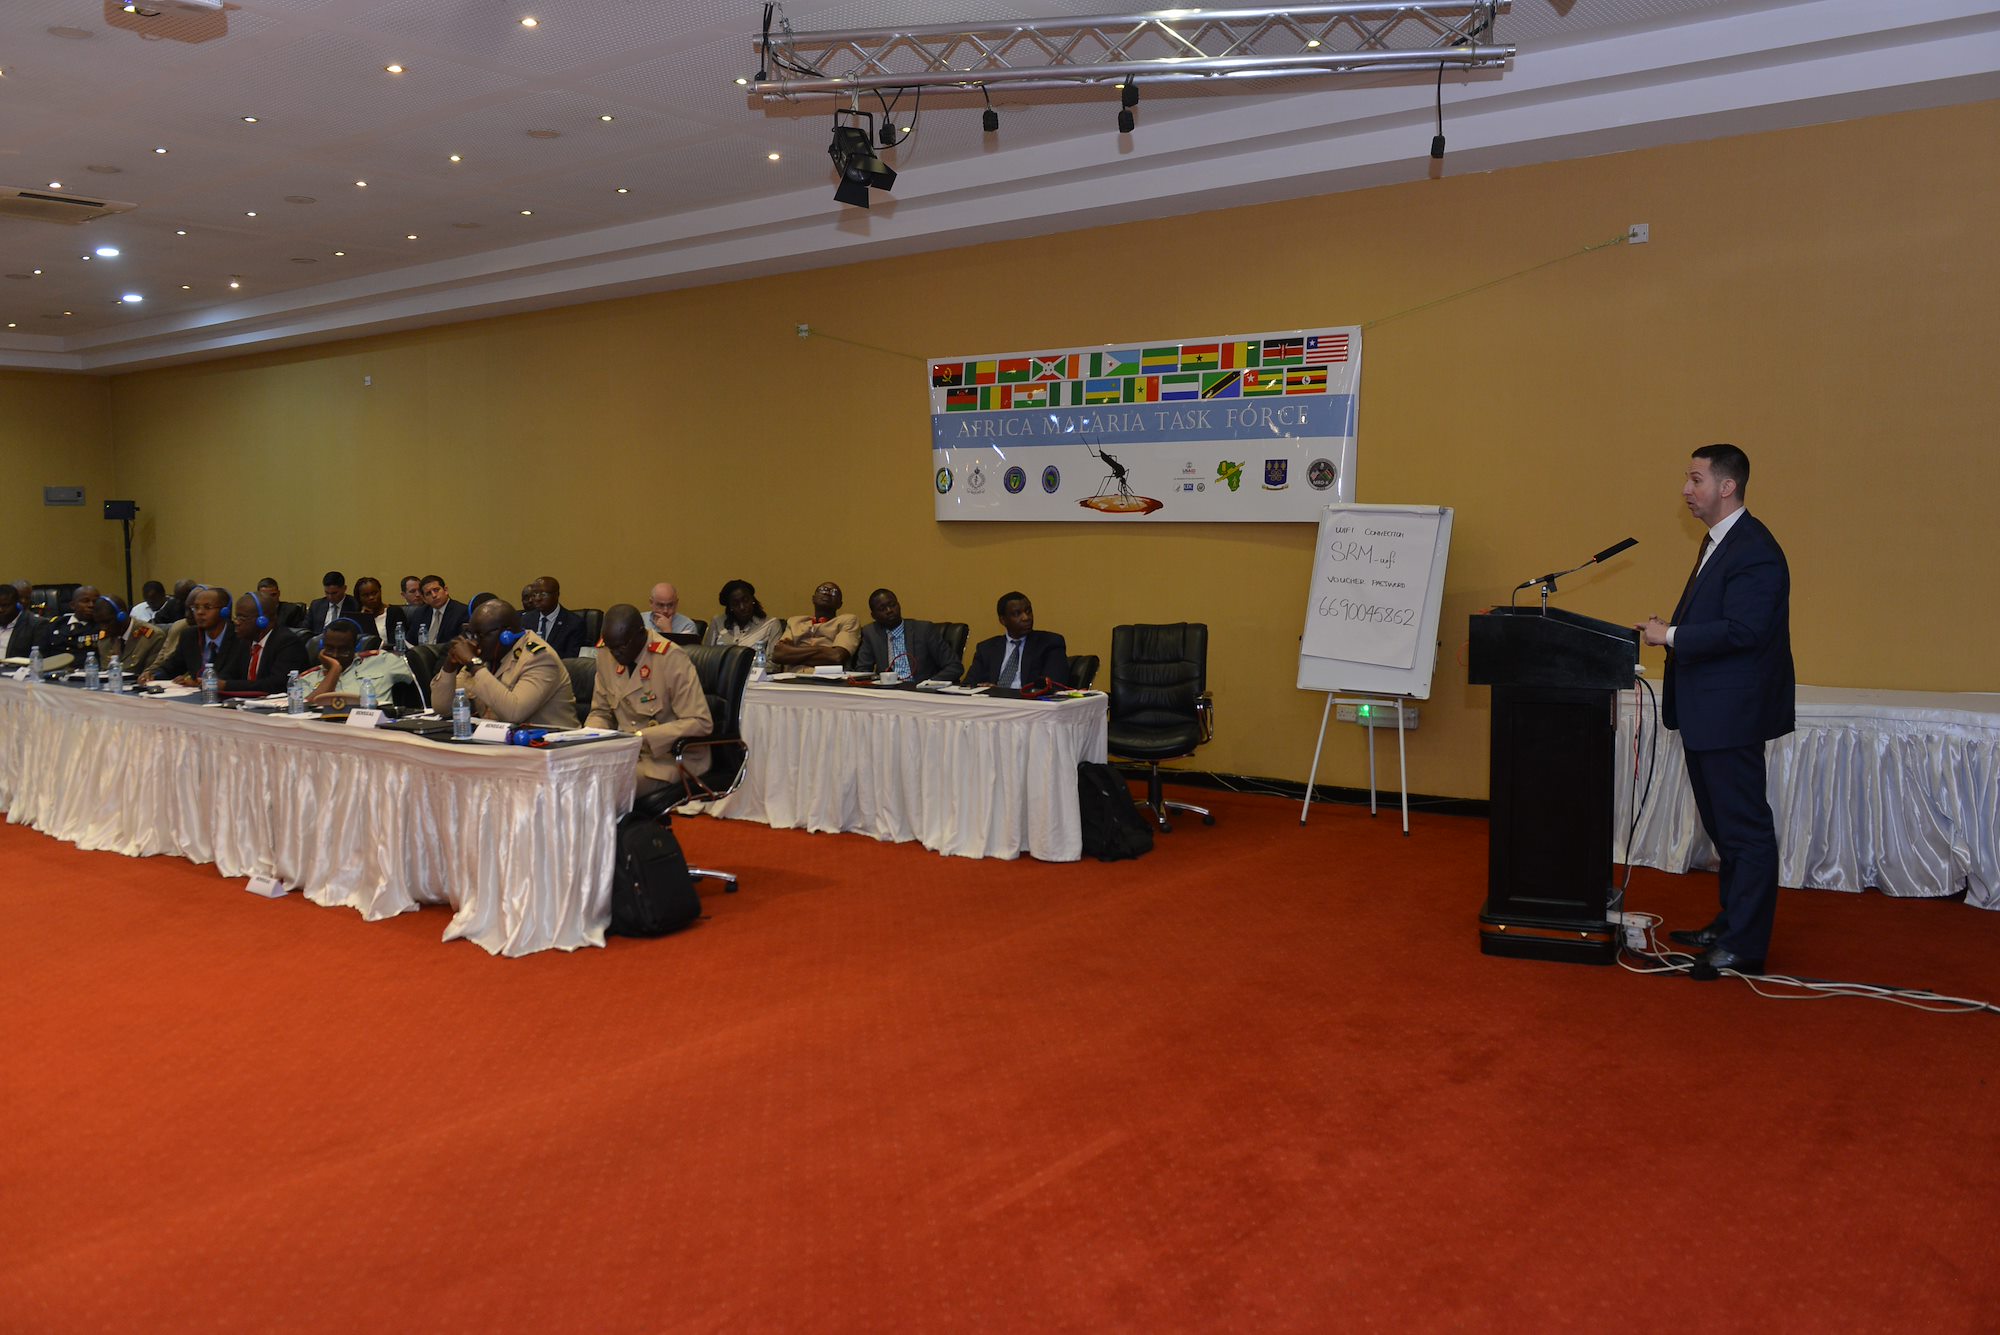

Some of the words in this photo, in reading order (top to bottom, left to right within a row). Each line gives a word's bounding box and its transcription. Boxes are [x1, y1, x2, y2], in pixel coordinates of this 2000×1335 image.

[956, 417, 1034, 438] AFRICA
[1043, 412, 1146, 435] MALARIA
[1154, 409, 1212, 432] TASK
[1225, 404, 1309, 428] FORCE
[1327, 575, 1365, 585] VOUCHER
[1318, 596, 1416, 627] 6690045862
